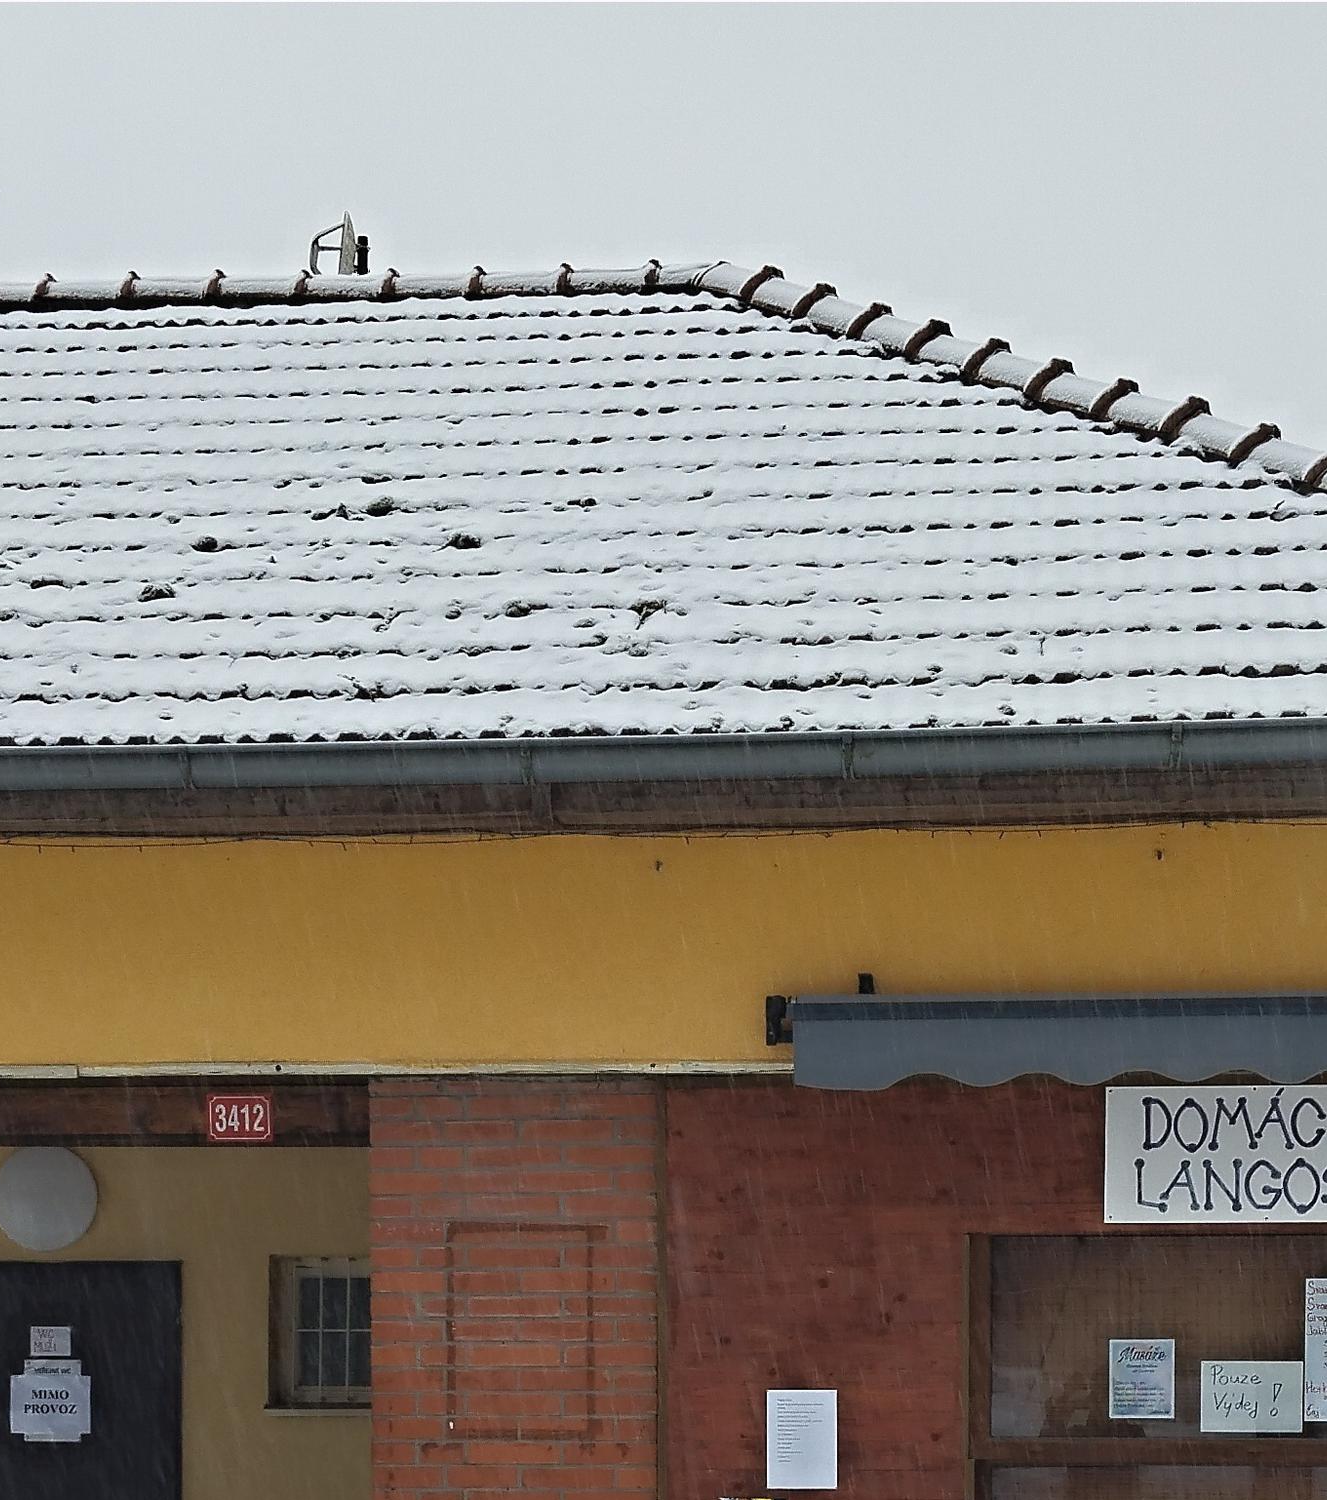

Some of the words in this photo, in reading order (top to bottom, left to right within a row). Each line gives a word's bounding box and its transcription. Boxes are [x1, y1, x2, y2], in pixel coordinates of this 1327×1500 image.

[215, 1104, 265, 1132] 3412
[1210, 1364, 1262, 1385] Pouze
[31, 1389, 69, 1401] MIMO
[1213, 1392, 1259, 1419] Výdej
[24, 1404, 78, 1415] PROVOZ
